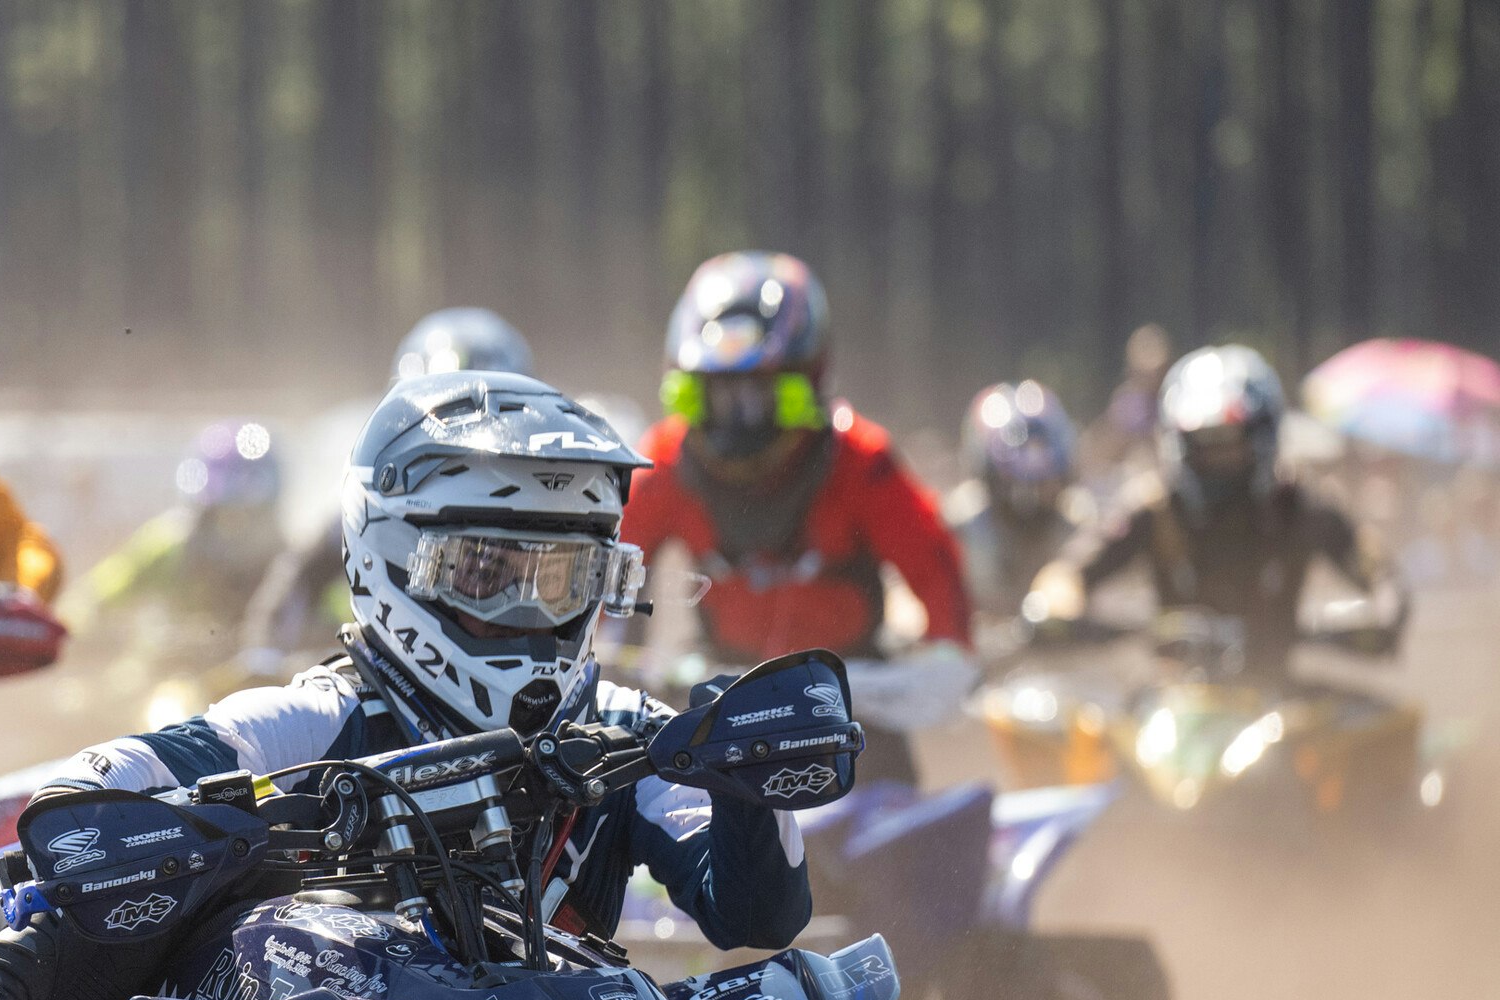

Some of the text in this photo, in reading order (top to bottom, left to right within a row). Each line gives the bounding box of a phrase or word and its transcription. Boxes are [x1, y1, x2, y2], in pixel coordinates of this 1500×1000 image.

[529, 432, 621, 452] FLY
[376, 600, 447, 679] 142
[531, 665, 557, 676] FLY
[727, 705, 795, 722] WORKS
[388, 750, 497, 784] flexx
[765, 765, 836, 796] IMS
[120, 827, 183, 844] WORKS
[126, 833, 184, 848] CONNECTION
[108, 896, 175, 929] IMS
[315, 950, 388, 996] Racing for
